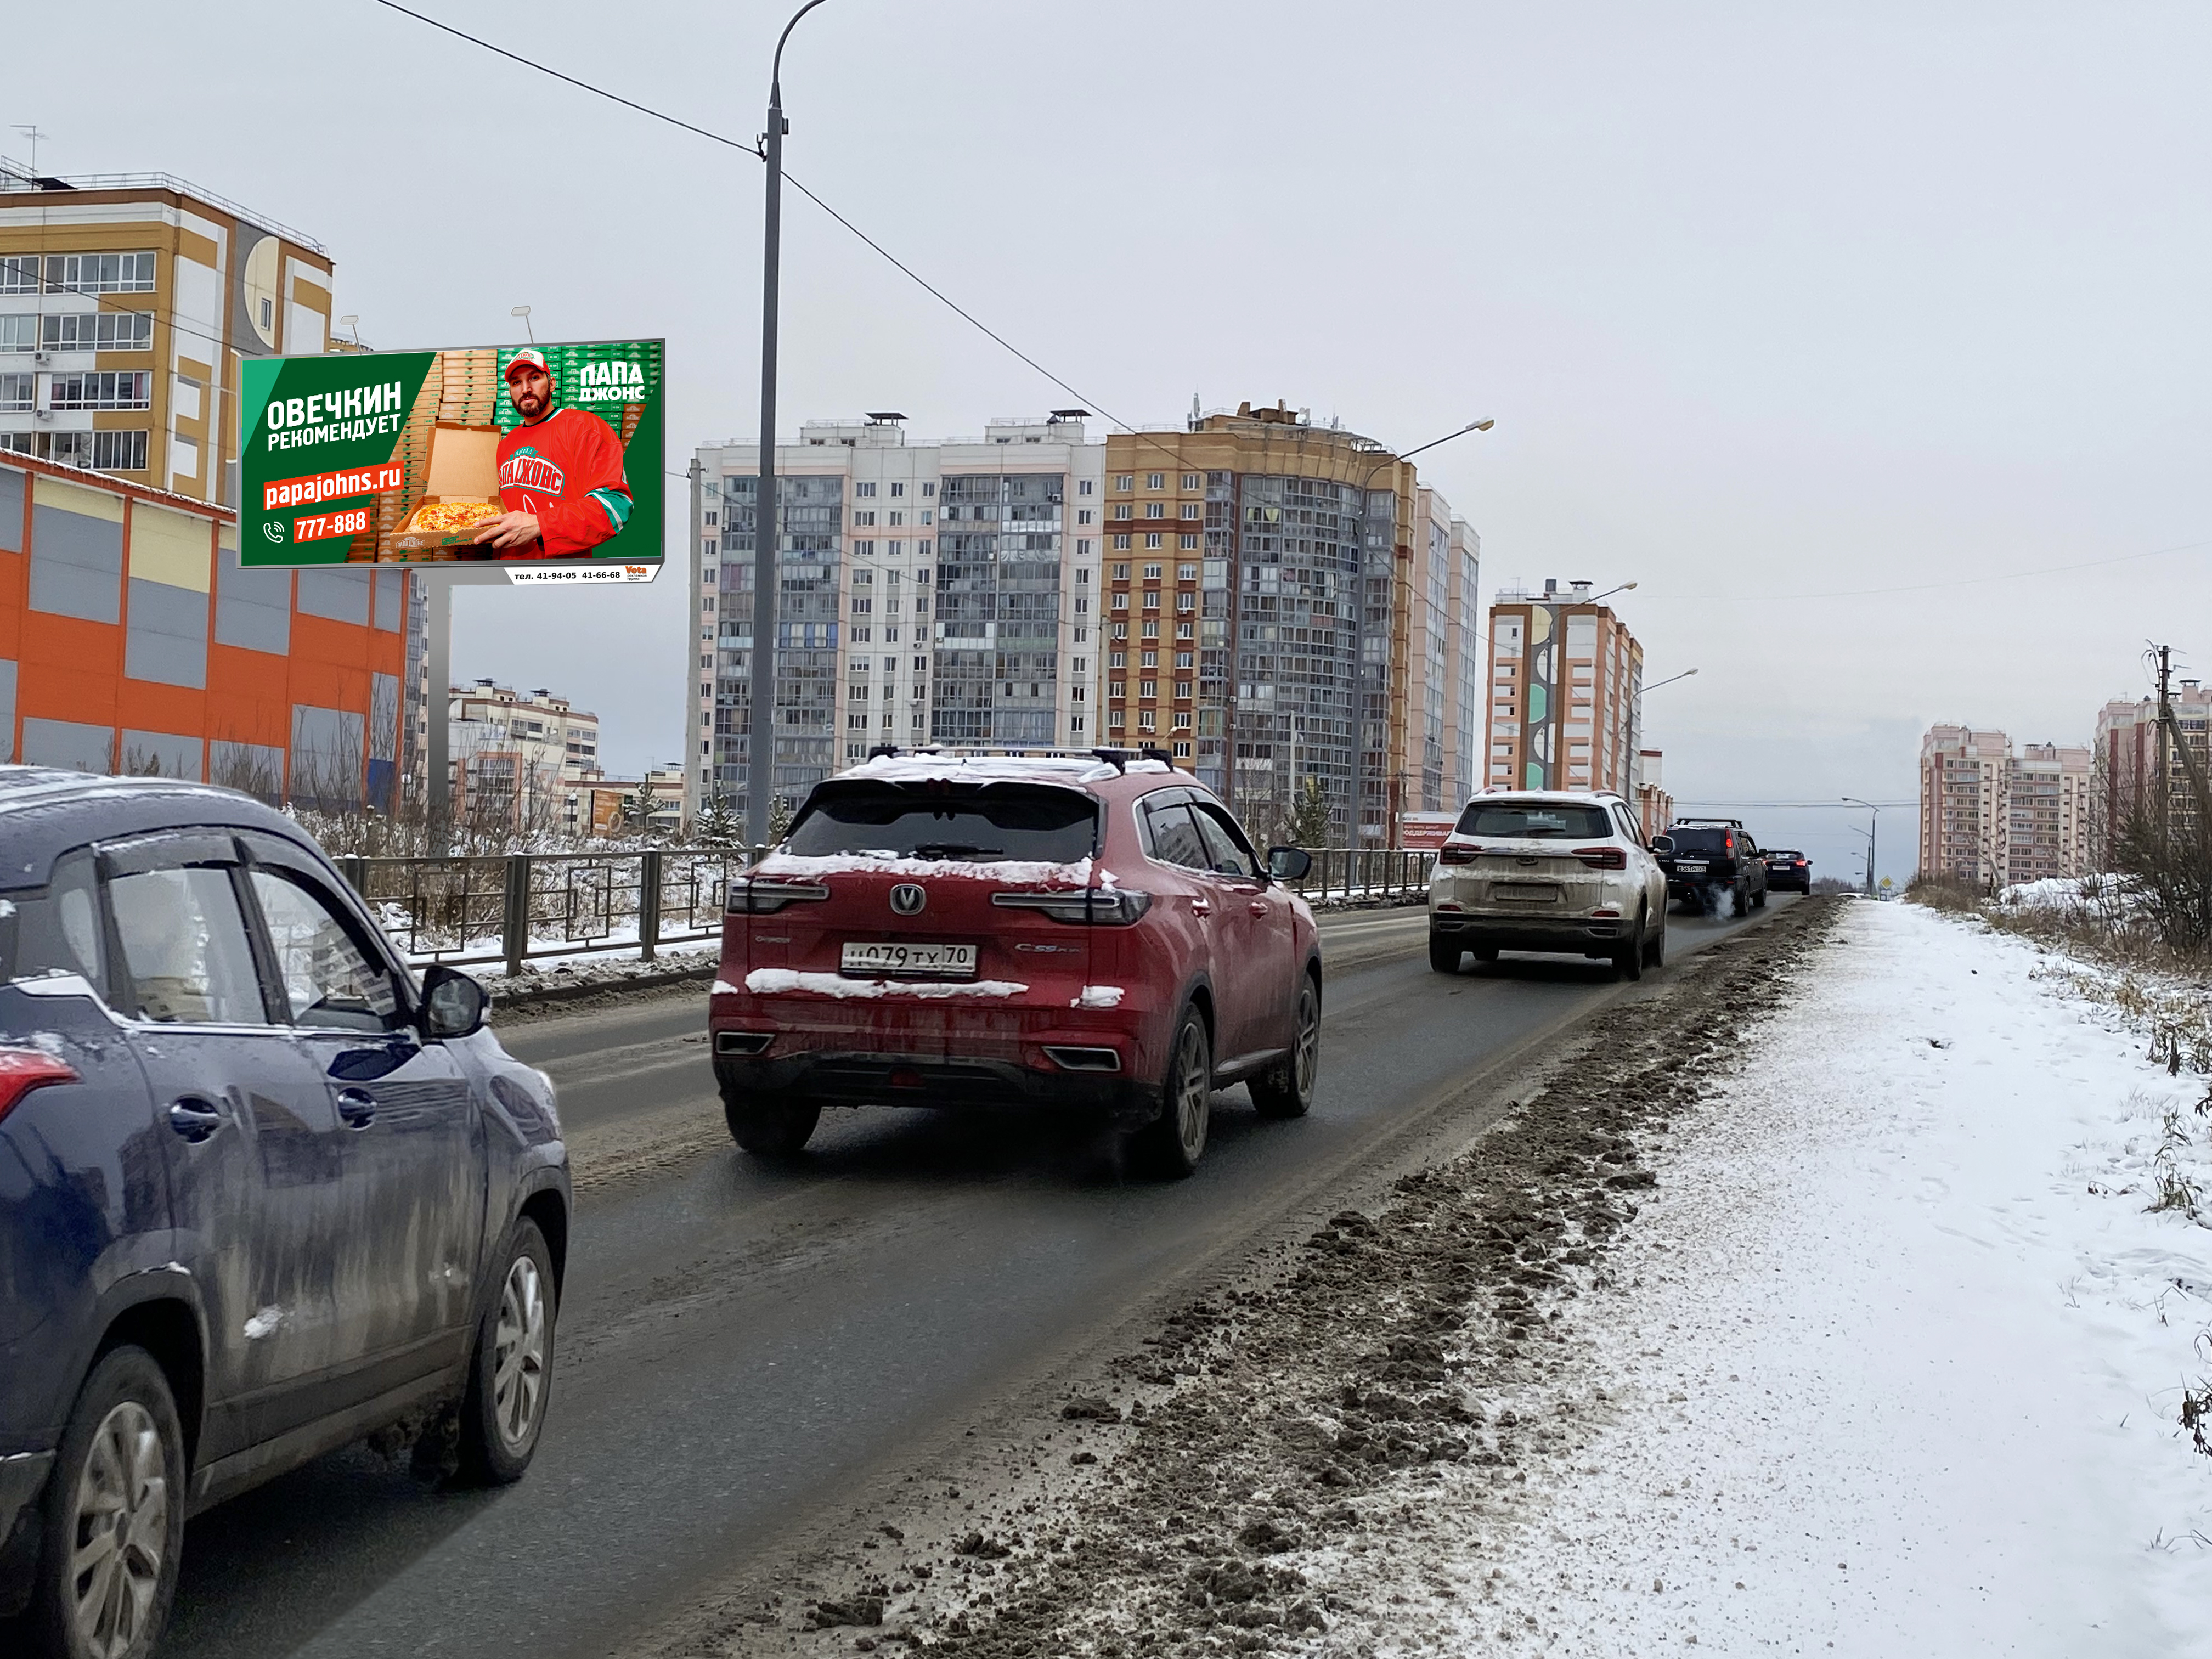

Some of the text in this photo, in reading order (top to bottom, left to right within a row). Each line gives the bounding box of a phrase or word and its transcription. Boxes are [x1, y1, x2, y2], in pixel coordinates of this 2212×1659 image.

[580, 361, 644, 386] ПАПА
[268, 381, 401, 430] ОВЕЧКИН
[579, 386, 645, 402] ДЖОНС
[268, 413, 401, 452] РЕКОМЕНДУЕТ
[266, 469, 400, 510] papajohns.ru
[297, 511, 366, 539] 777-888
[625, 566, 647, 574] Vota
[946, 947, 967, 963] 70
